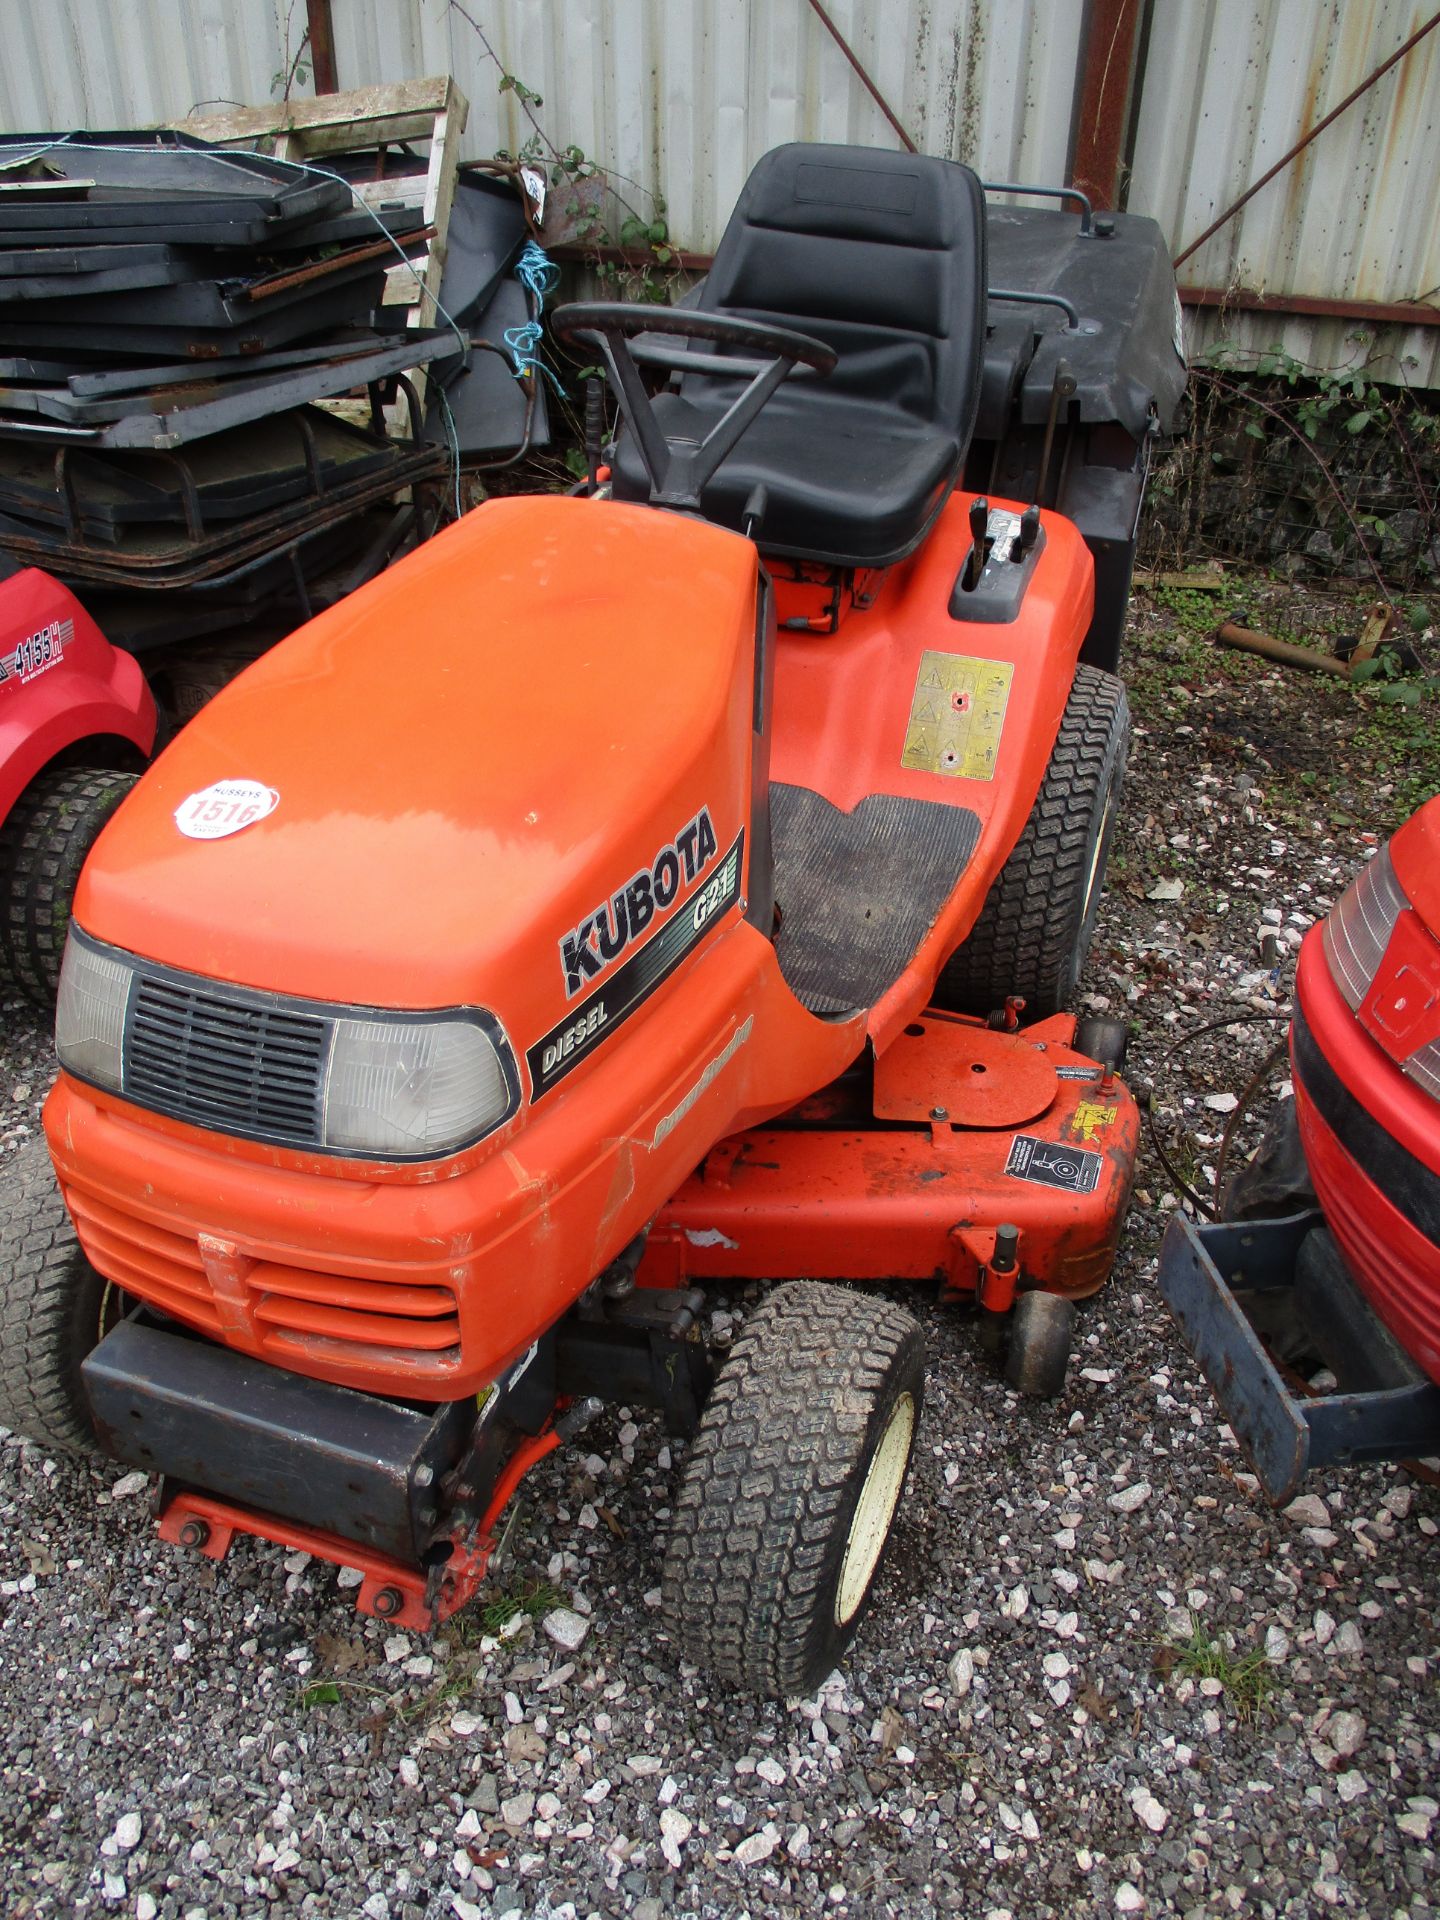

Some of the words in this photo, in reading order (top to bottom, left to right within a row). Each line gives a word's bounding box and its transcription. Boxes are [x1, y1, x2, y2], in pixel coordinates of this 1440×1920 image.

[15, 621, 63, 677] 4155H
[189, 799, 261, 824] 1516
[213, 787, 262, 799] HUSSEYS
[557, 804, 718, 1001] KUBOTA
[693, 865, 728, 930] G21
[542, 1002, 608, 1073] DIESEL
